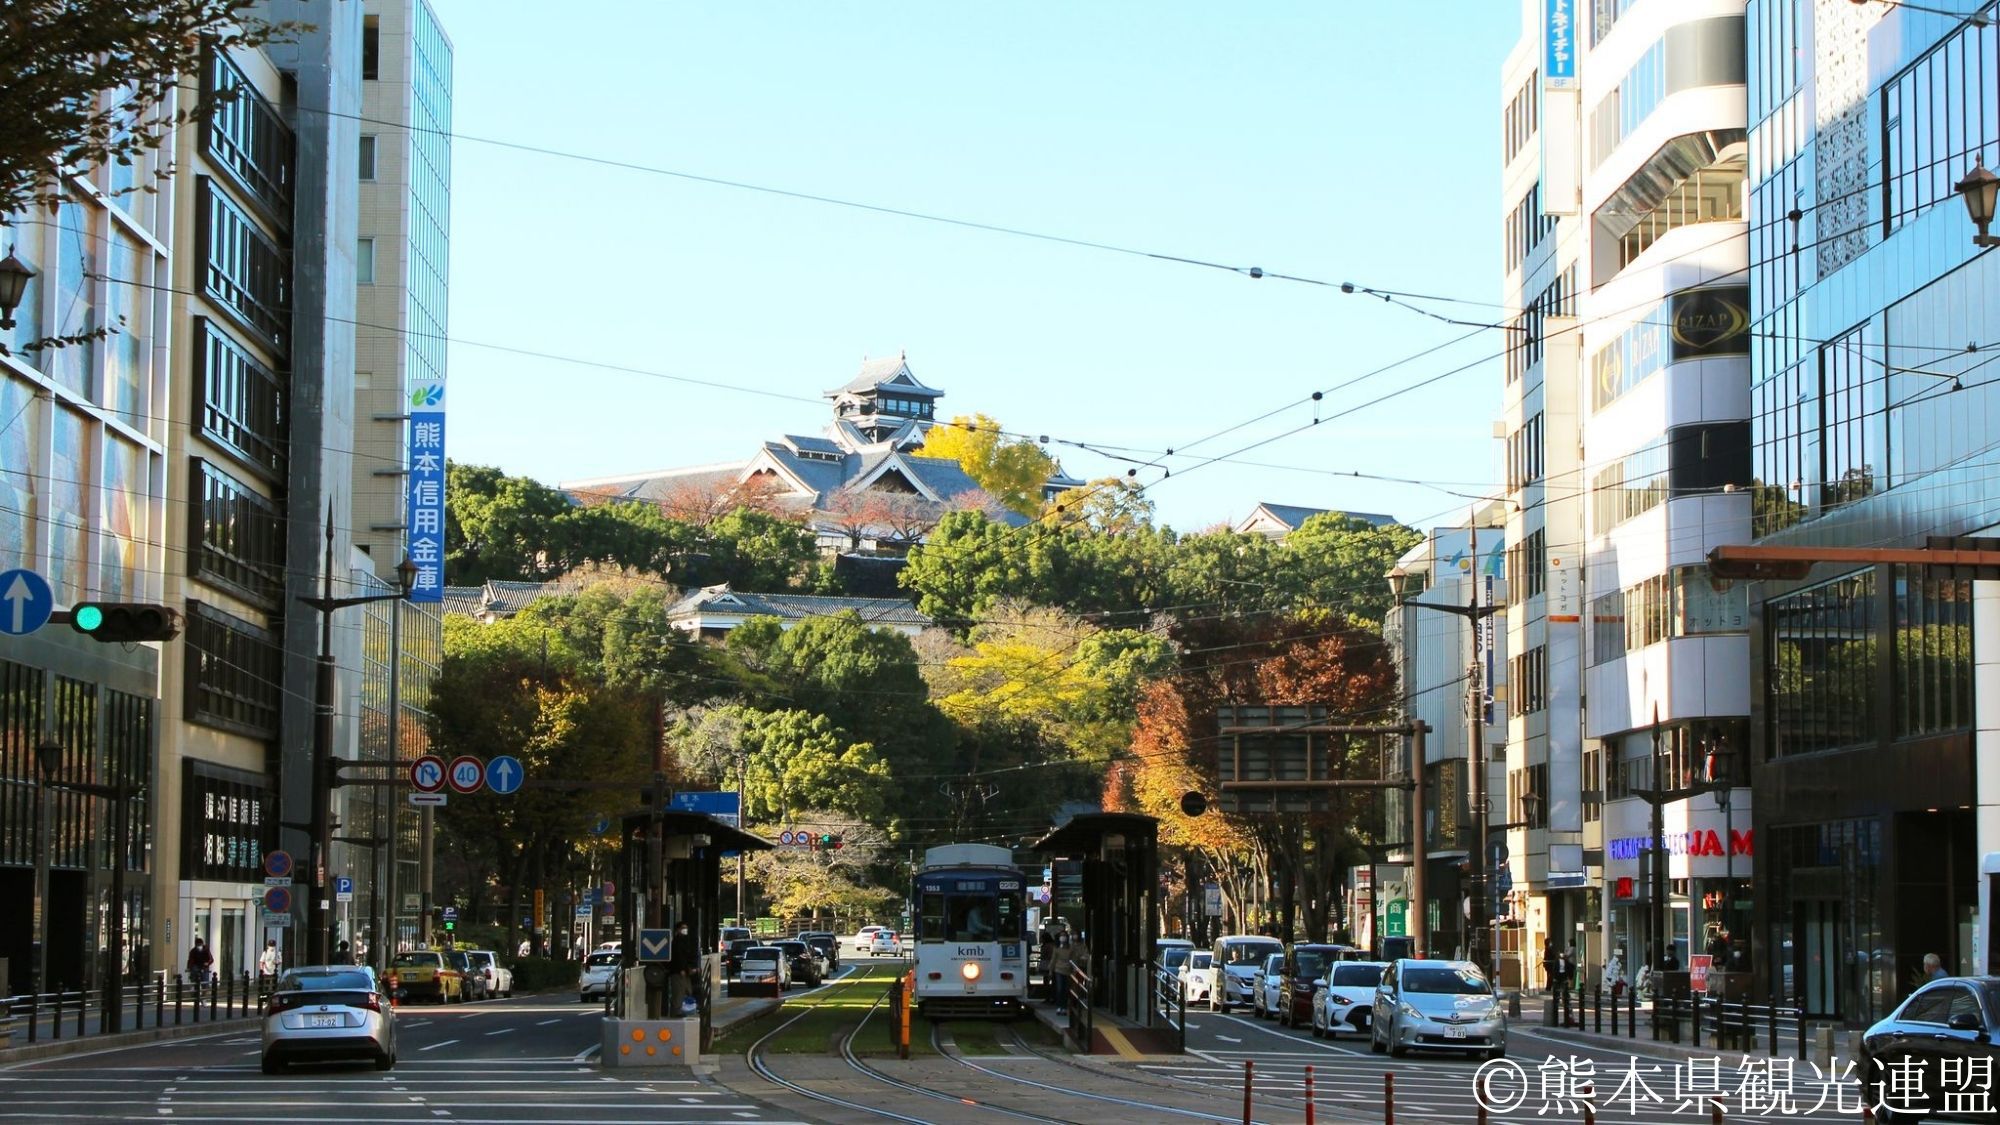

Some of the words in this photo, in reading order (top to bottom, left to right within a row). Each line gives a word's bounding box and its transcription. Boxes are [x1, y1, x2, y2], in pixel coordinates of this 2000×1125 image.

[1680, 313, 1728, 328] RIZAP
[412, 422, 440, 591] 熊本信用金庫
[457, 766, 477, 782] 40
[1690, 829, 1755, 857] JAM
[341, 880, 350, 892] P
[958, 946, 984, 957] kmb
[1007, 946, 1016, 956] B
